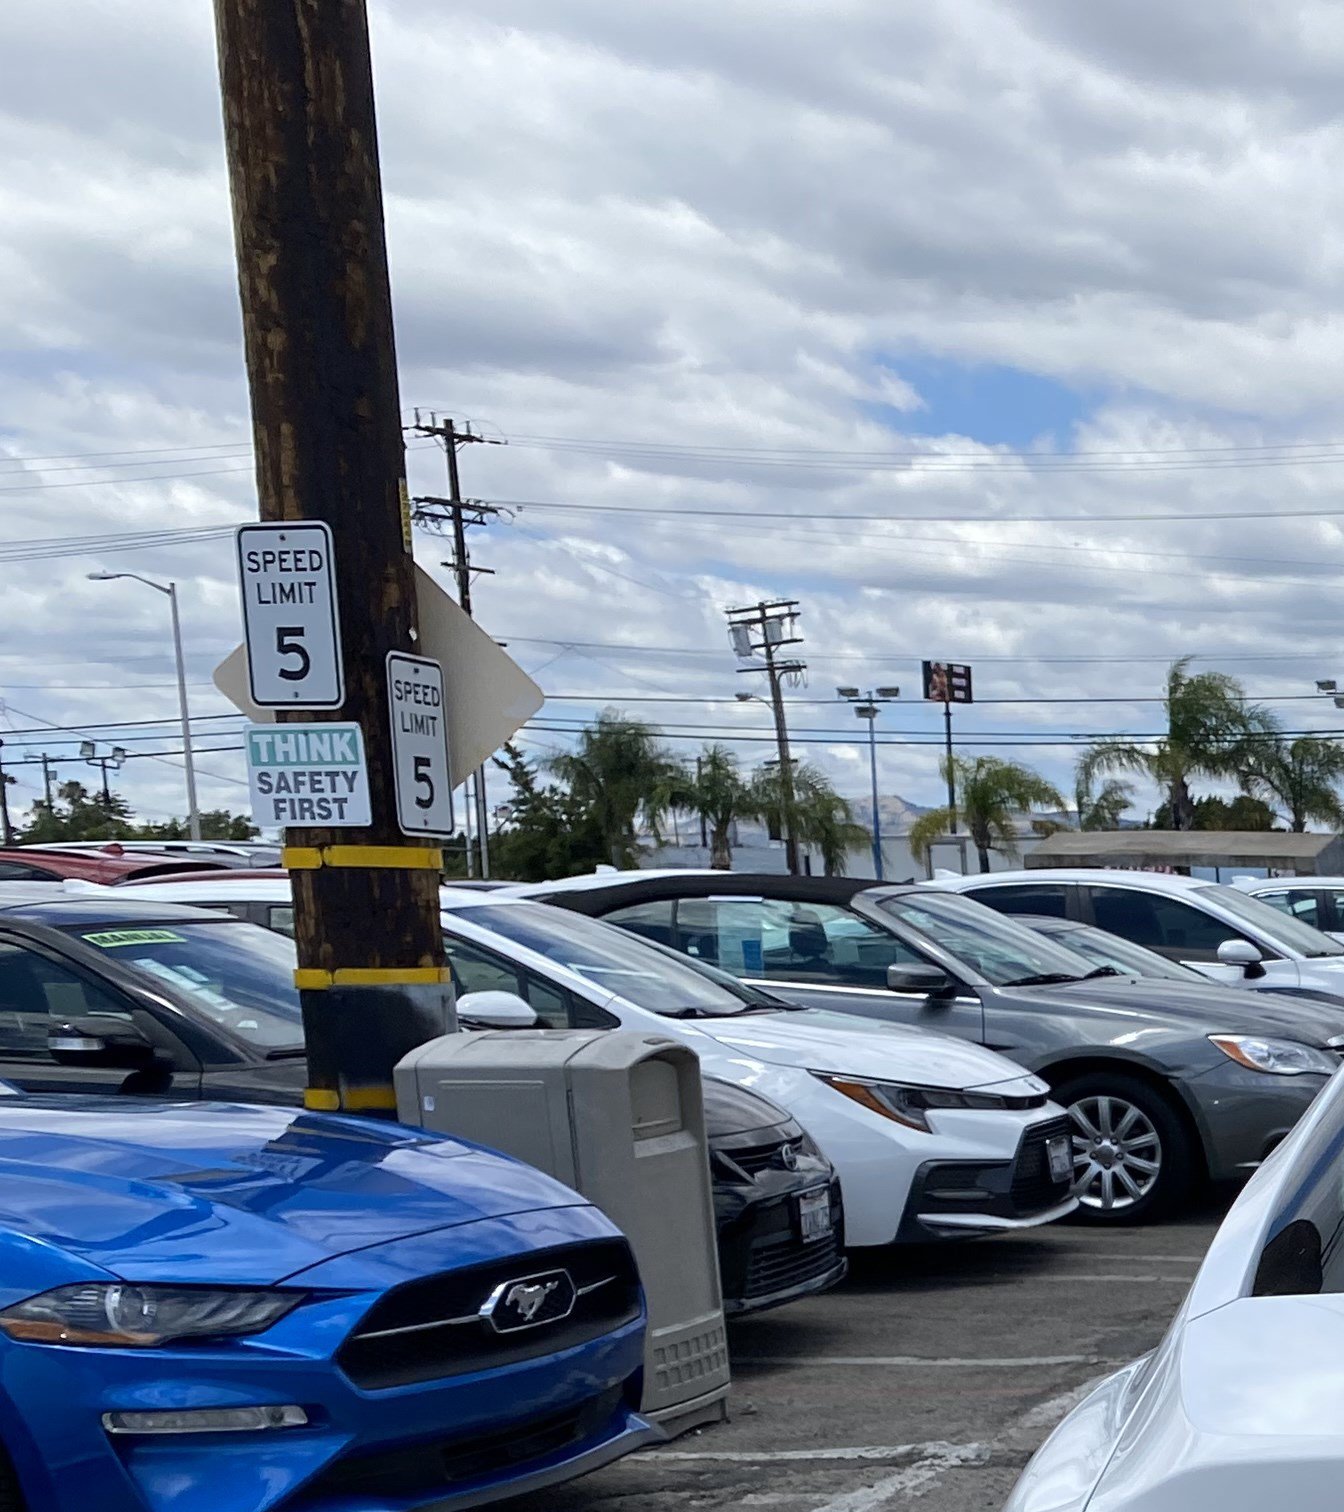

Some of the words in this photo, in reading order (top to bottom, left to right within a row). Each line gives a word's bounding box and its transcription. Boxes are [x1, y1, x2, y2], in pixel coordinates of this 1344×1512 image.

[247, 550, 323, 573] SPEED
[257, 581, 317, 605] LIMIT
[276, 626, 311, 681] 5
[394, 679, 440, 708] SPEED
[401, 712, 438, 738] LIMIT
[252, 732, 357, 764] THINK
[257, 770, 359, 795] SAFETY
[413, 755, 435, 810] 5
[273, 797, 348, 821] FIRST
